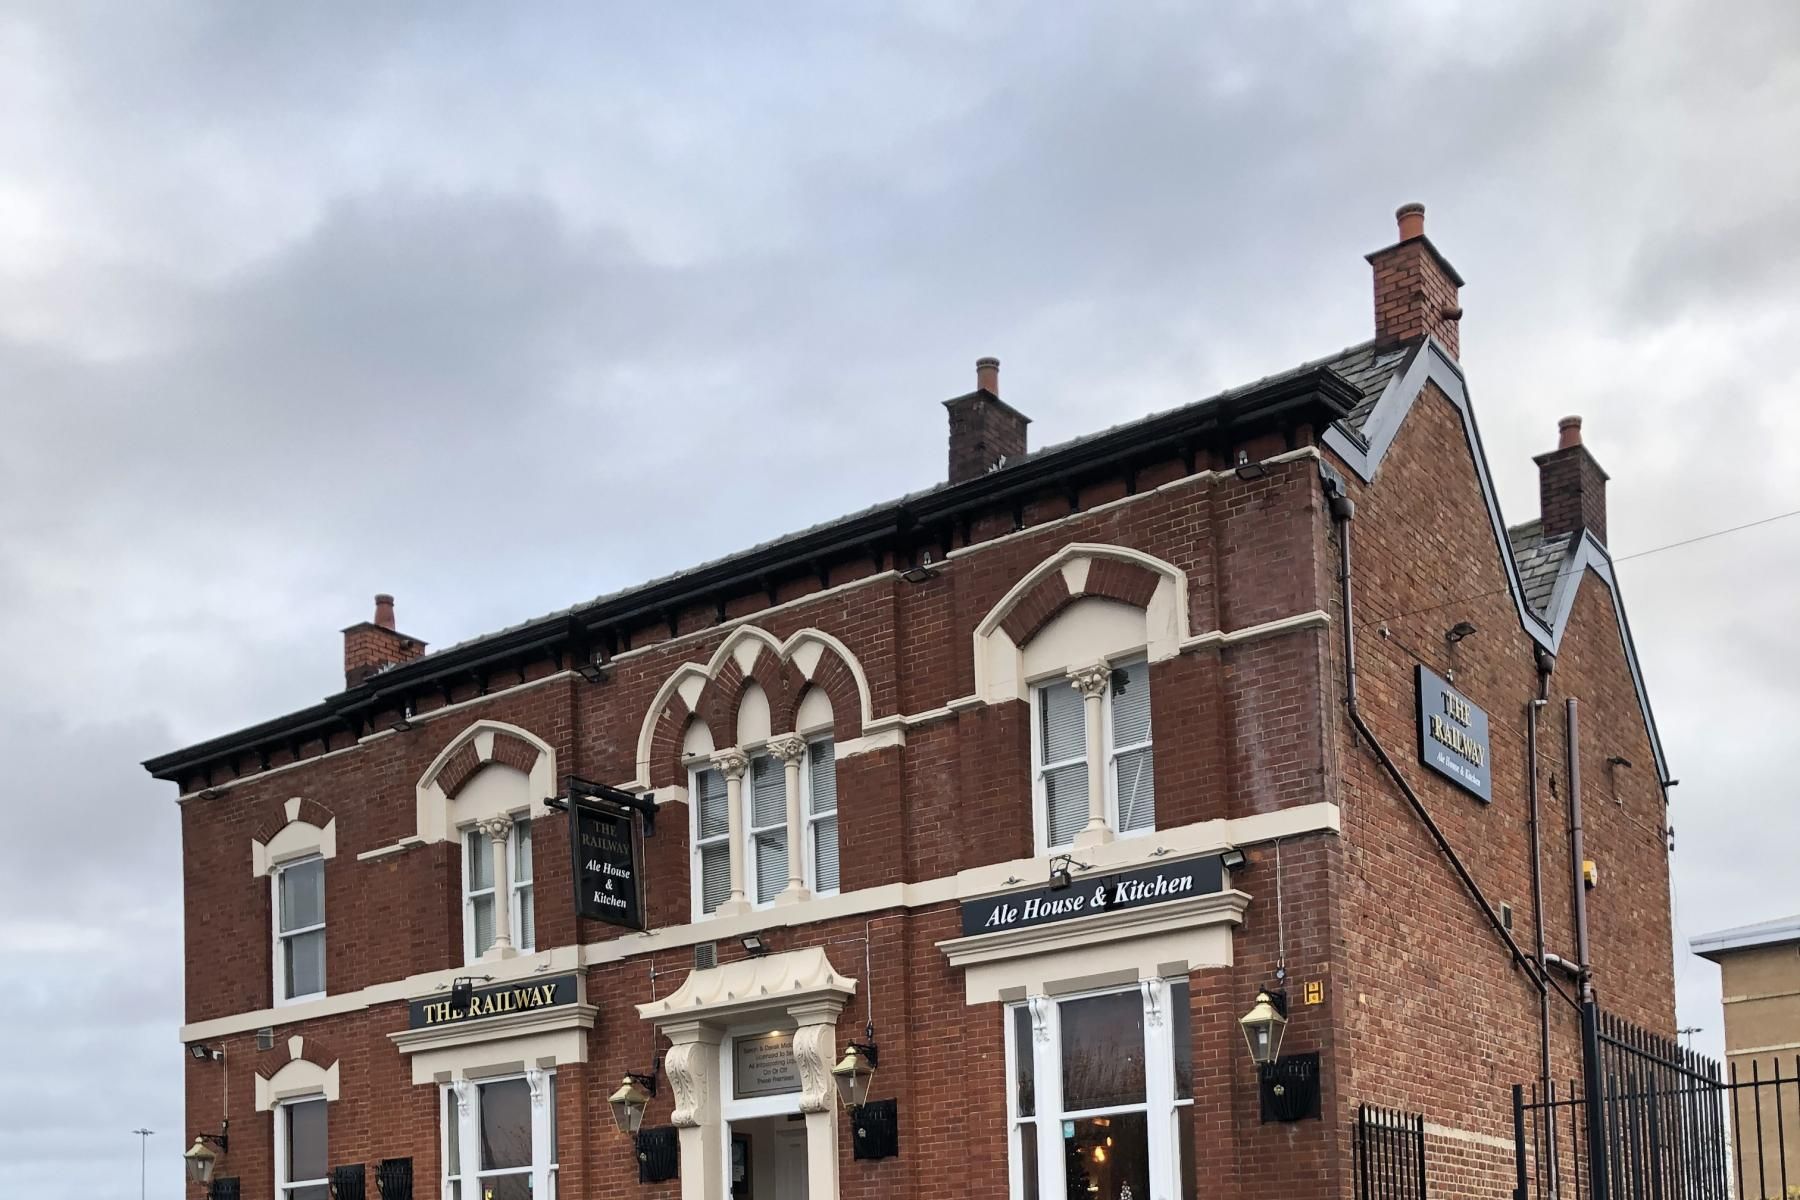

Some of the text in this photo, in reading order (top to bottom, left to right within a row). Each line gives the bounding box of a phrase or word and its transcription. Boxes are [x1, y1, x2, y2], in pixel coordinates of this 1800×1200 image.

[1447, 690, 1472, 727] THE
[1435, 714, 1485, 767] RAILWAY
[593, 821, 617, 837] THE
[581, 833, 630, 855] RAILWAY
[586, 859, 631, 879] Ale House
[605, 879, 613, 890] &
[593, 891, 627, 908] Kitchen
[985, 874, 1193, 927] Ale House & Kitchen
[468, 983, 556, 1017] RAILWAY
